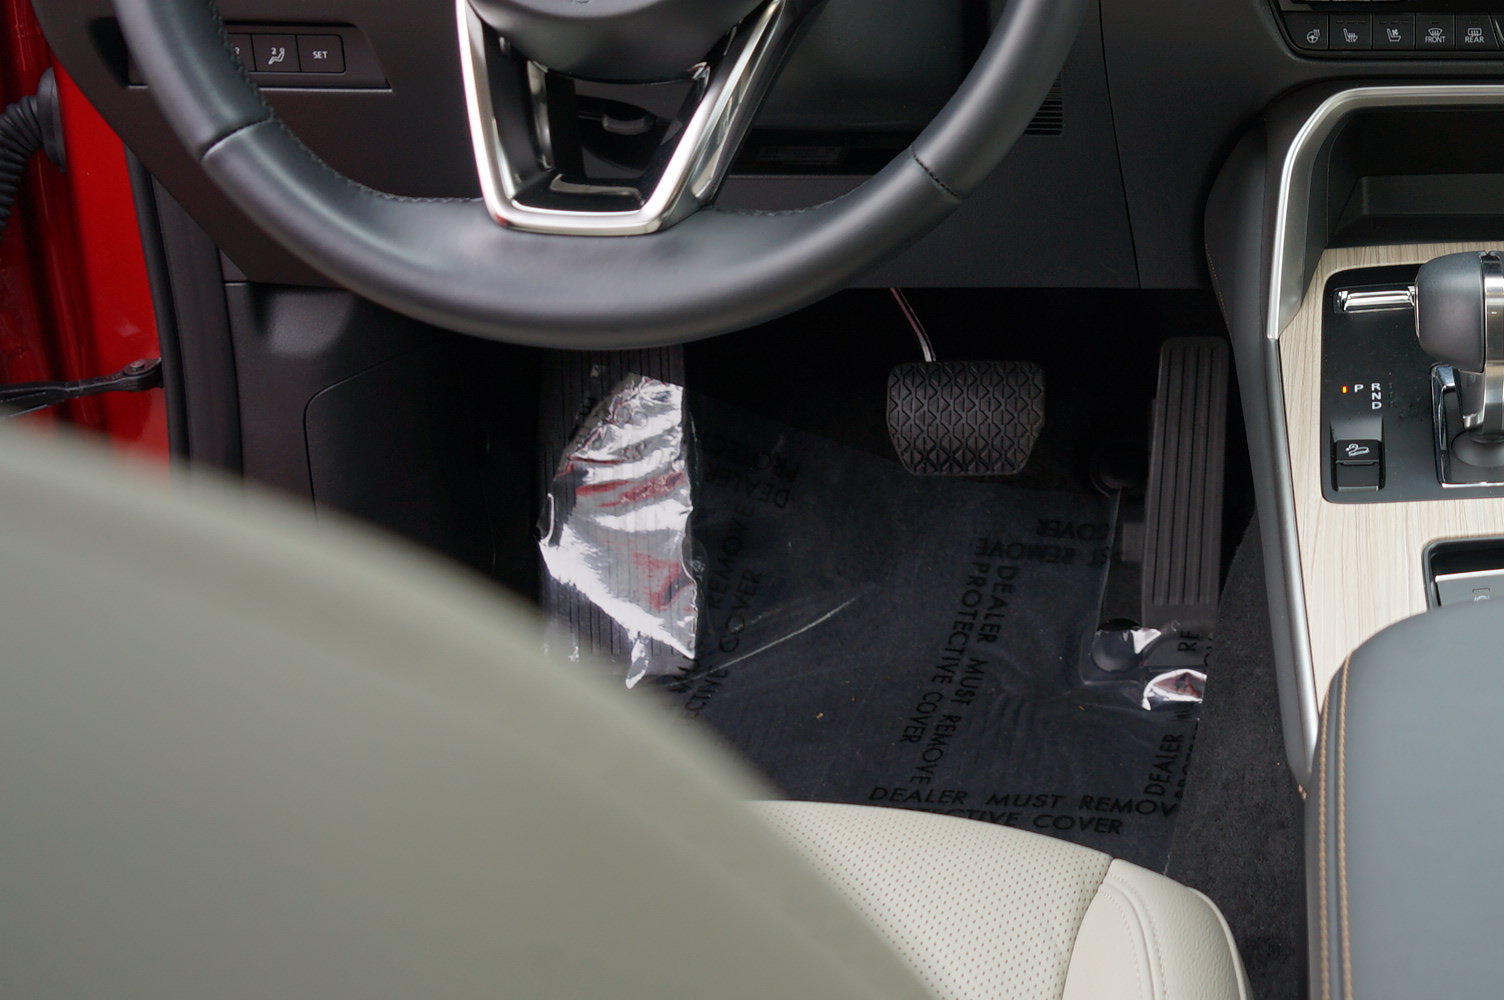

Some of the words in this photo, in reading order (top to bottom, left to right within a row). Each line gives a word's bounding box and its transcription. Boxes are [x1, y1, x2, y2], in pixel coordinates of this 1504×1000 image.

[1425, 36, 1446, 44] FRONT
[1464, 36, 1485, 44] REAR
[312, 51, 328, 59] SET
[1354, 384, 1364, 392] P
[1371, 383, 1381, 391] R
[1372, 401, 1382, 409] D
[719, 568, 762, 653] COVER
[977, 565, 1020, 644] DEALER
[931, 561, 991, 685] PROTECTIVE
[951, 657, 988, 706] MUST
[900, 691, 943, 744] COVER
[910, 714, 962, 785] REMOVE
[1144, 733, 1184, 796] DEALER
[868, 786, 968, 805] DEALER
[985, 793, 1066, 810] MUST
[1033, 814, 1124, 835] COVER
